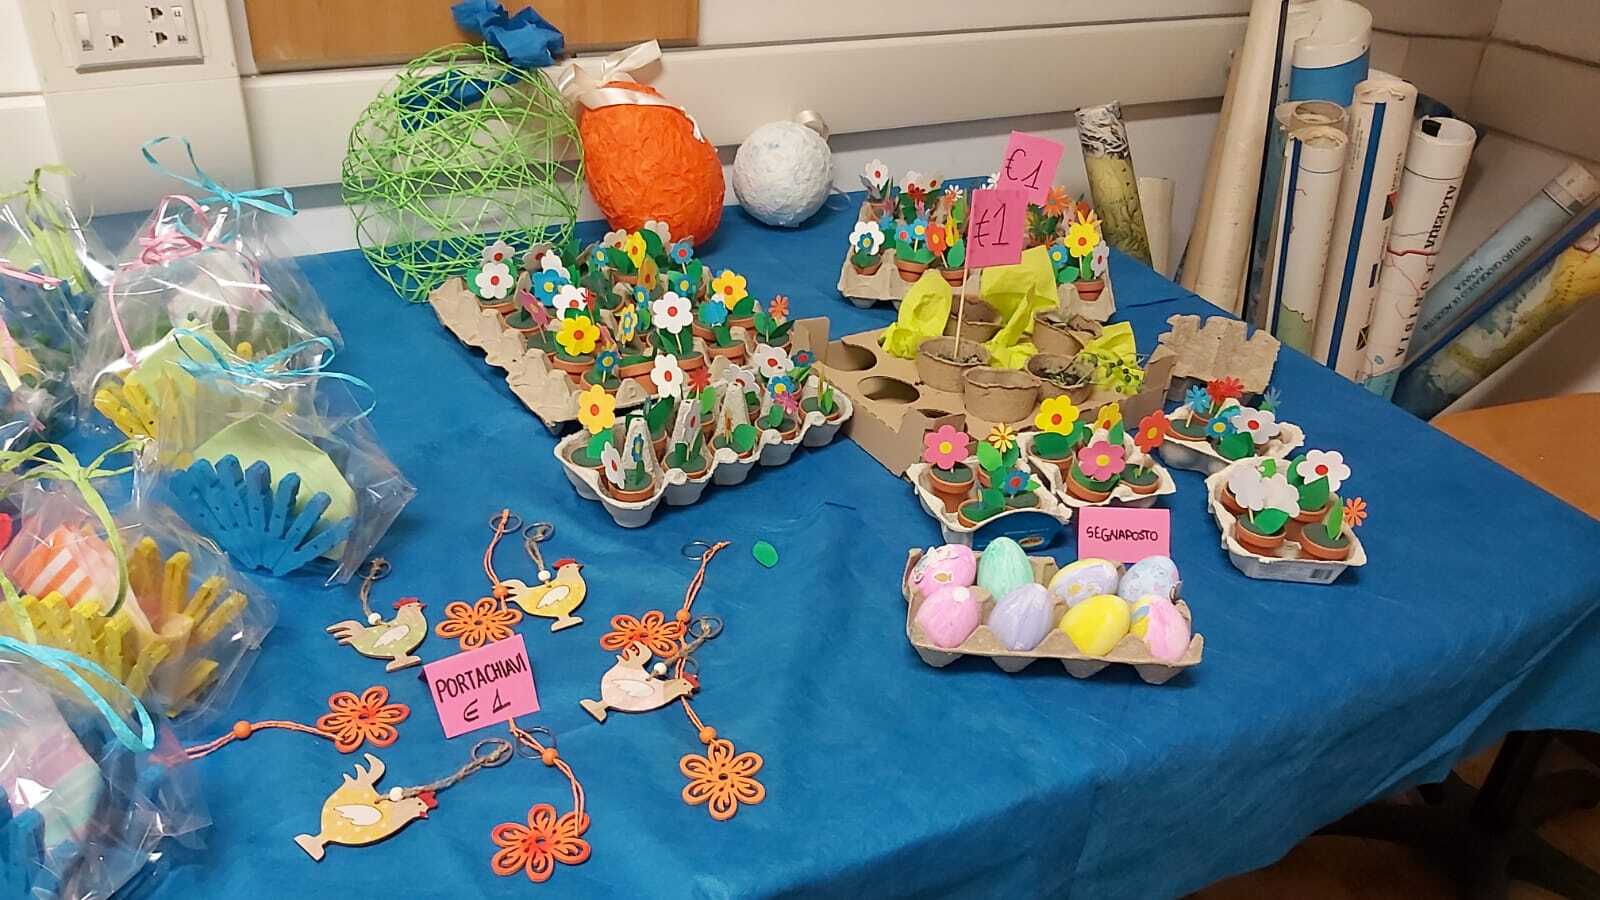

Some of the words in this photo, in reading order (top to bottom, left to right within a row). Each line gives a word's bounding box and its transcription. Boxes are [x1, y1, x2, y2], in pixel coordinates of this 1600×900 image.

[1005, 148, 1043, 190] €1
[974, 203, 1009, 247] €1
[1086, 526, 1158, 542] SEGNAPOSTO
[435, 652, 527, 703] PORTACHIAVI
